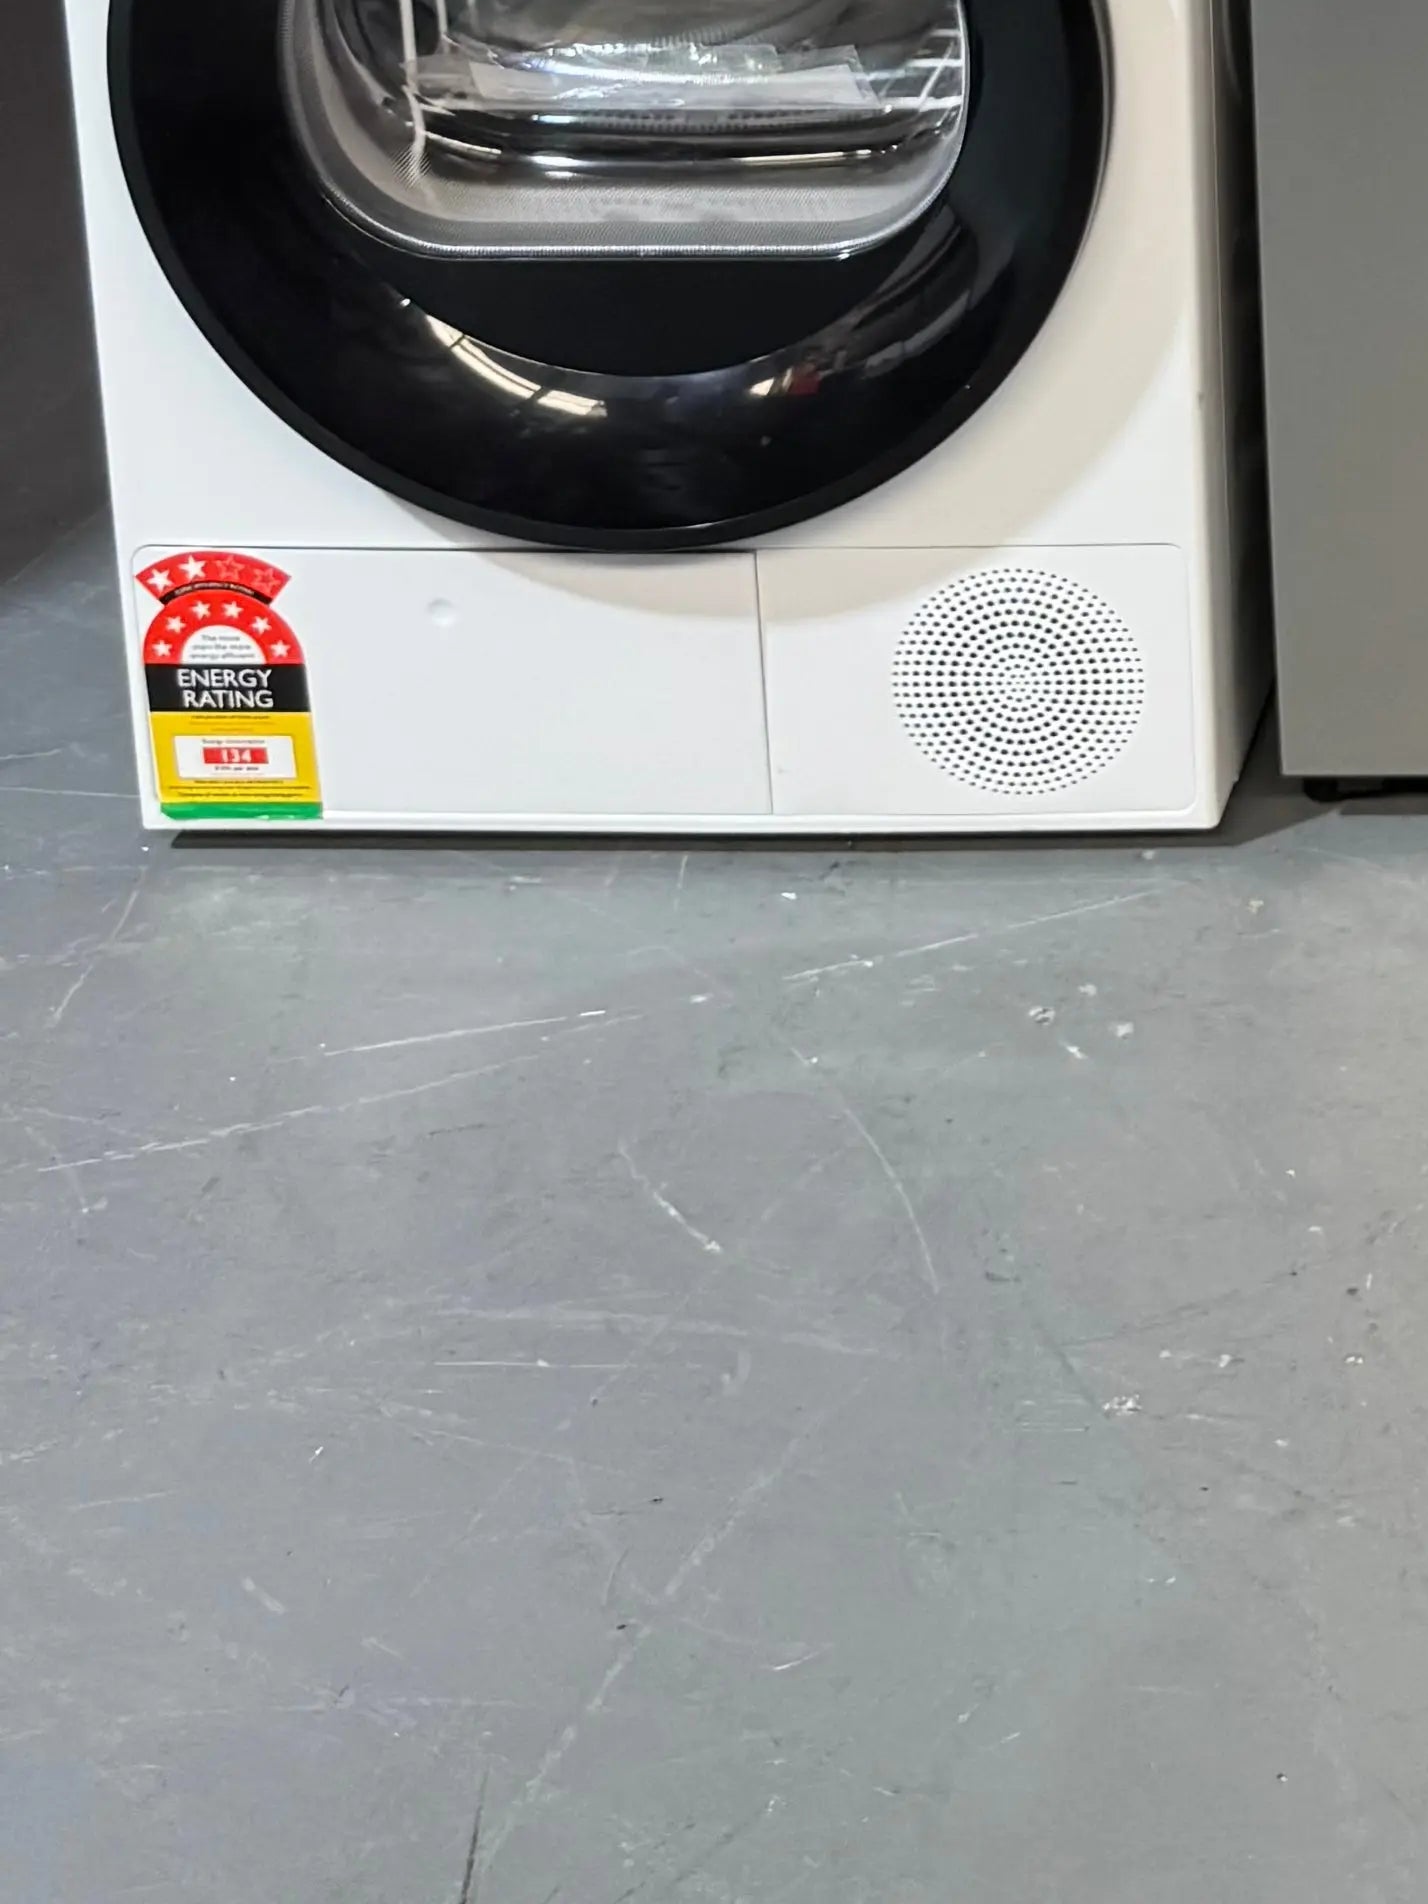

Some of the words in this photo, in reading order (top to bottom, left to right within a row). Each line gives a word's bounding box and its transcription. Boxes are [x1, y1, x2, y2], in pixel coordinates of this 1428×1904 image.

[177, 668, 272, 689] ENERGY
[184, 689, 274, 709] RATING
[221, 748, 253, 763] 134
